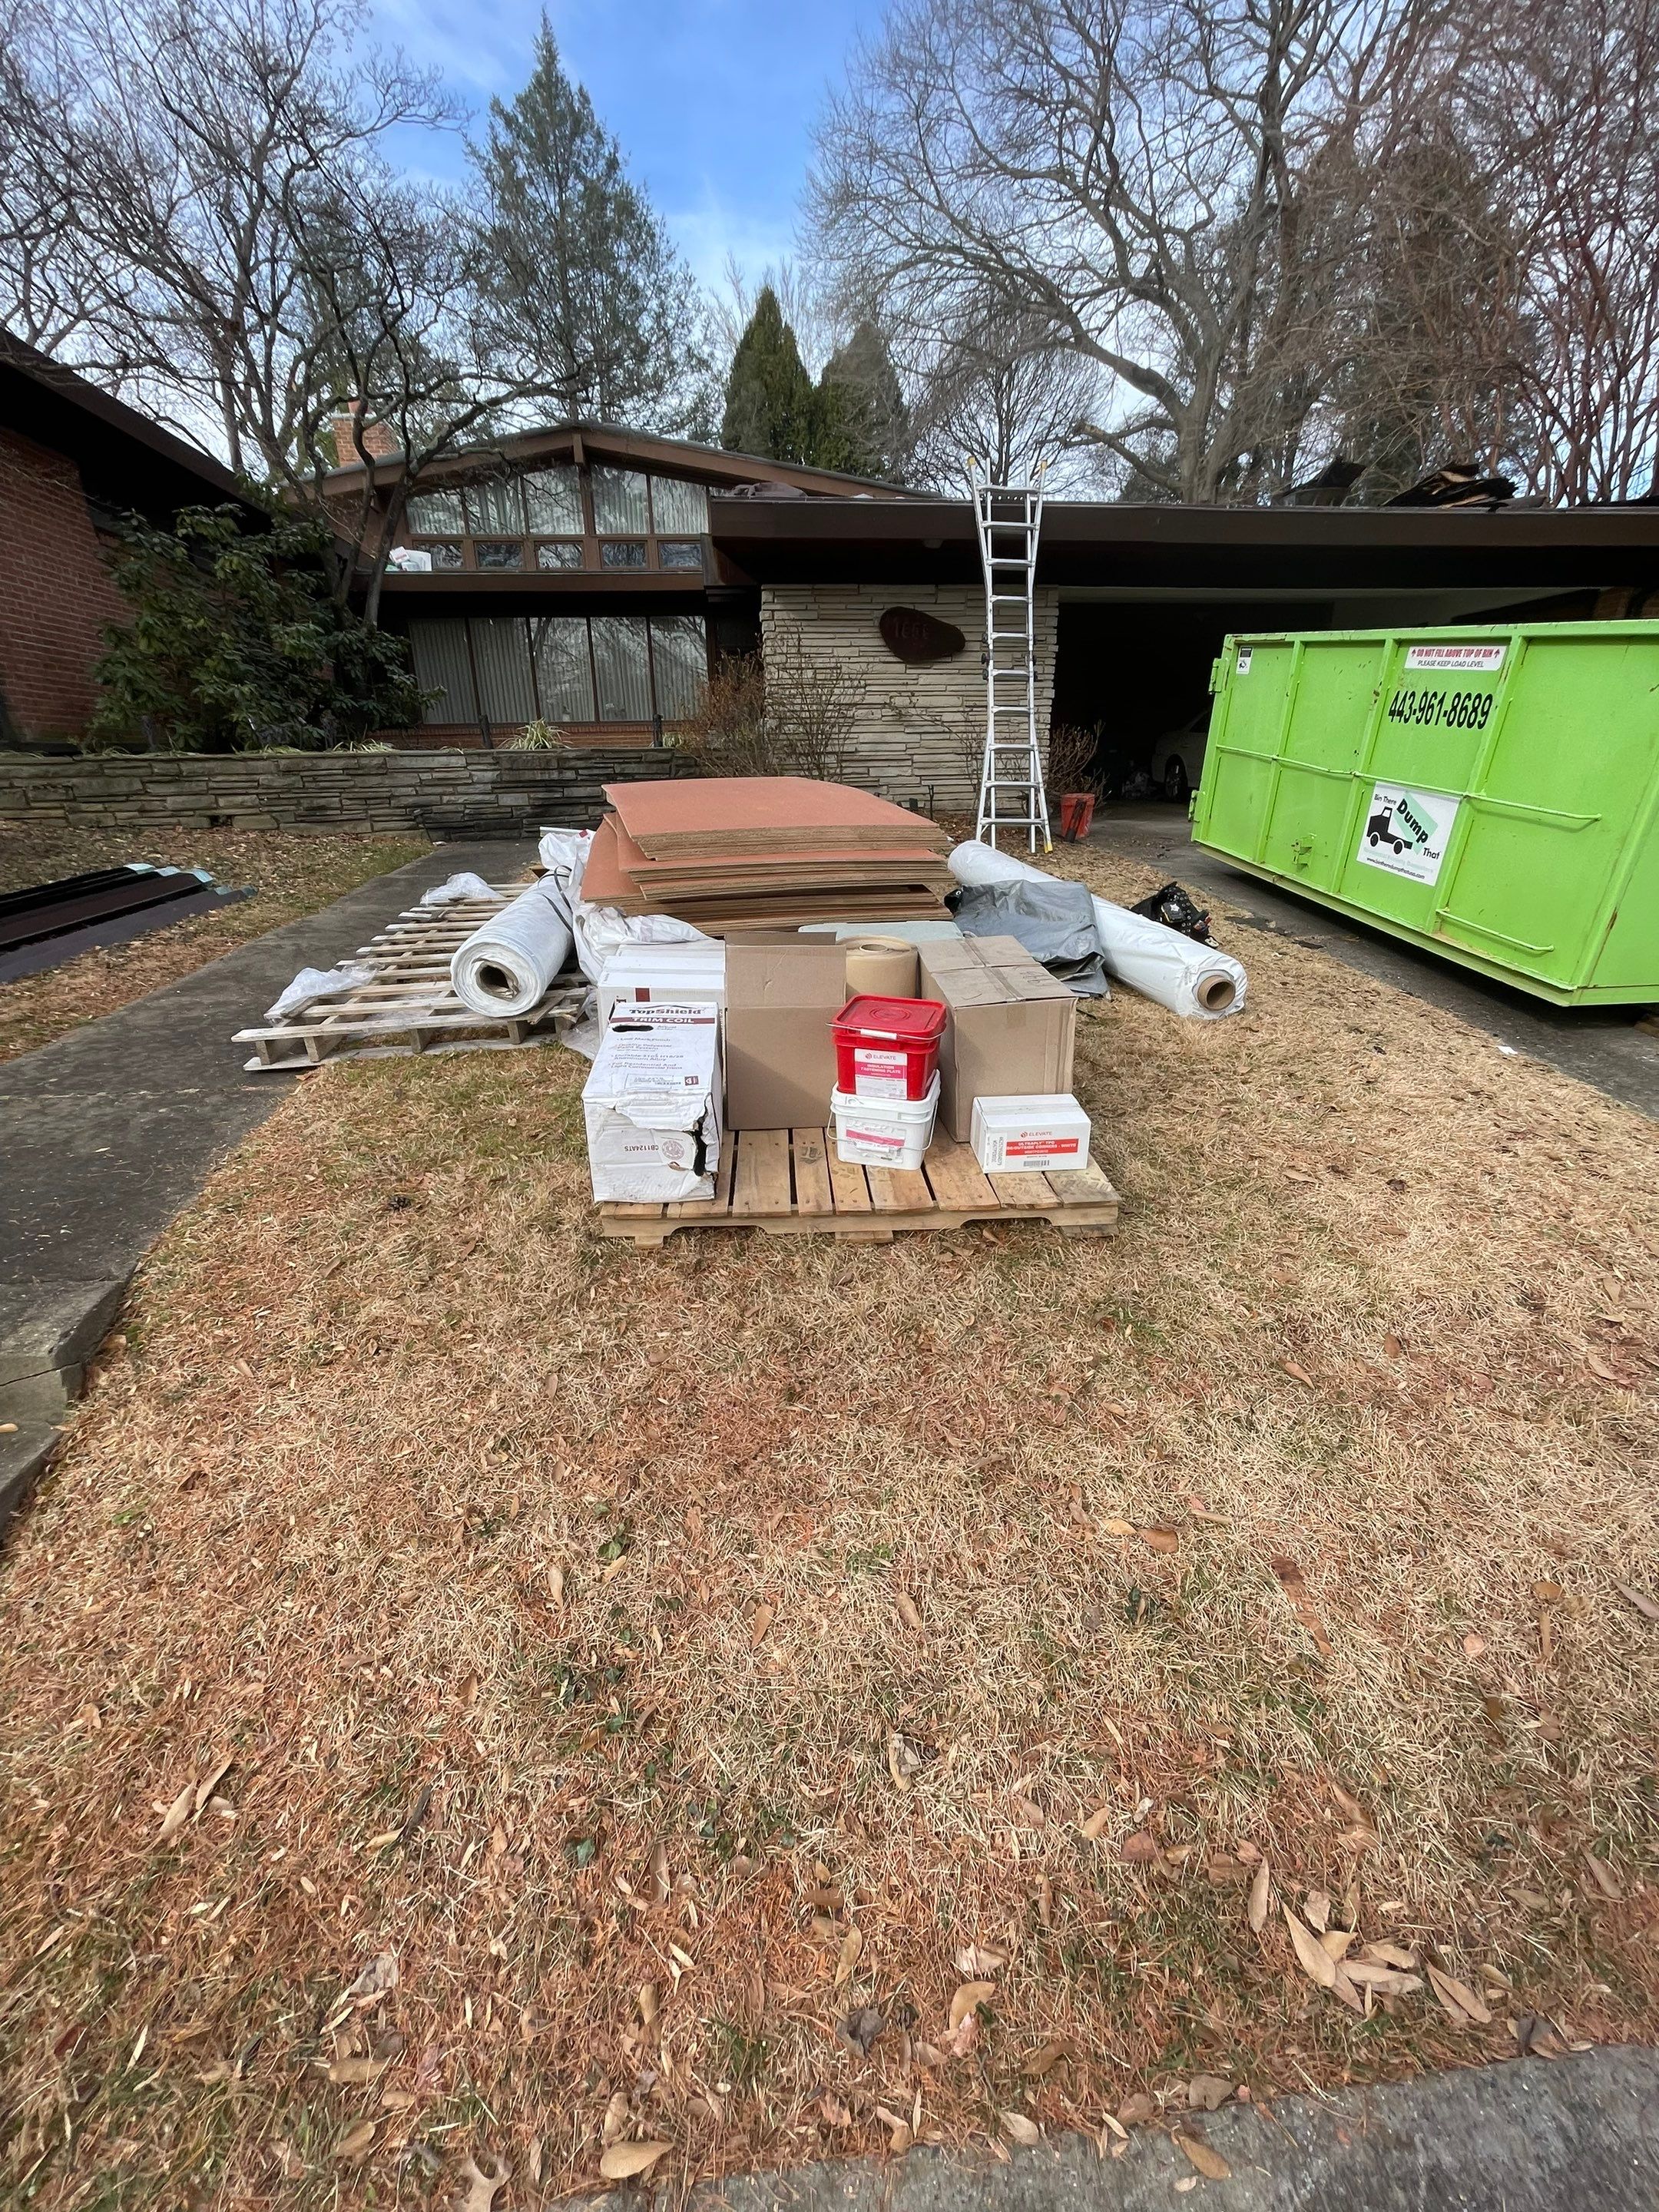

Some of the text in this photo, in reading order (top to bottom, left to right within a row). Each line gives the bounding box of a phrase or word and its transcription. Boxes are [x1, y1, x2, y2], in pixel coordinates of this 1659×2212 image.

[1424, 649, 1435, 657] NOT
[1435, 649, 1445, 657] FILL
[1445, 649, 1462, 657] ABOVE
[1463, 649, 1474, 657] TOP
[1474, 649, 1482, 657] OF
[1482, 649, 1495, 657] BIN
[1388, 690, 1493, 730] 443-961-8689
[1374, 793, 1397, 806] Bin There
[1396, 798, 1429, 843] Dump
[1423, 847, 1440, 859] That
